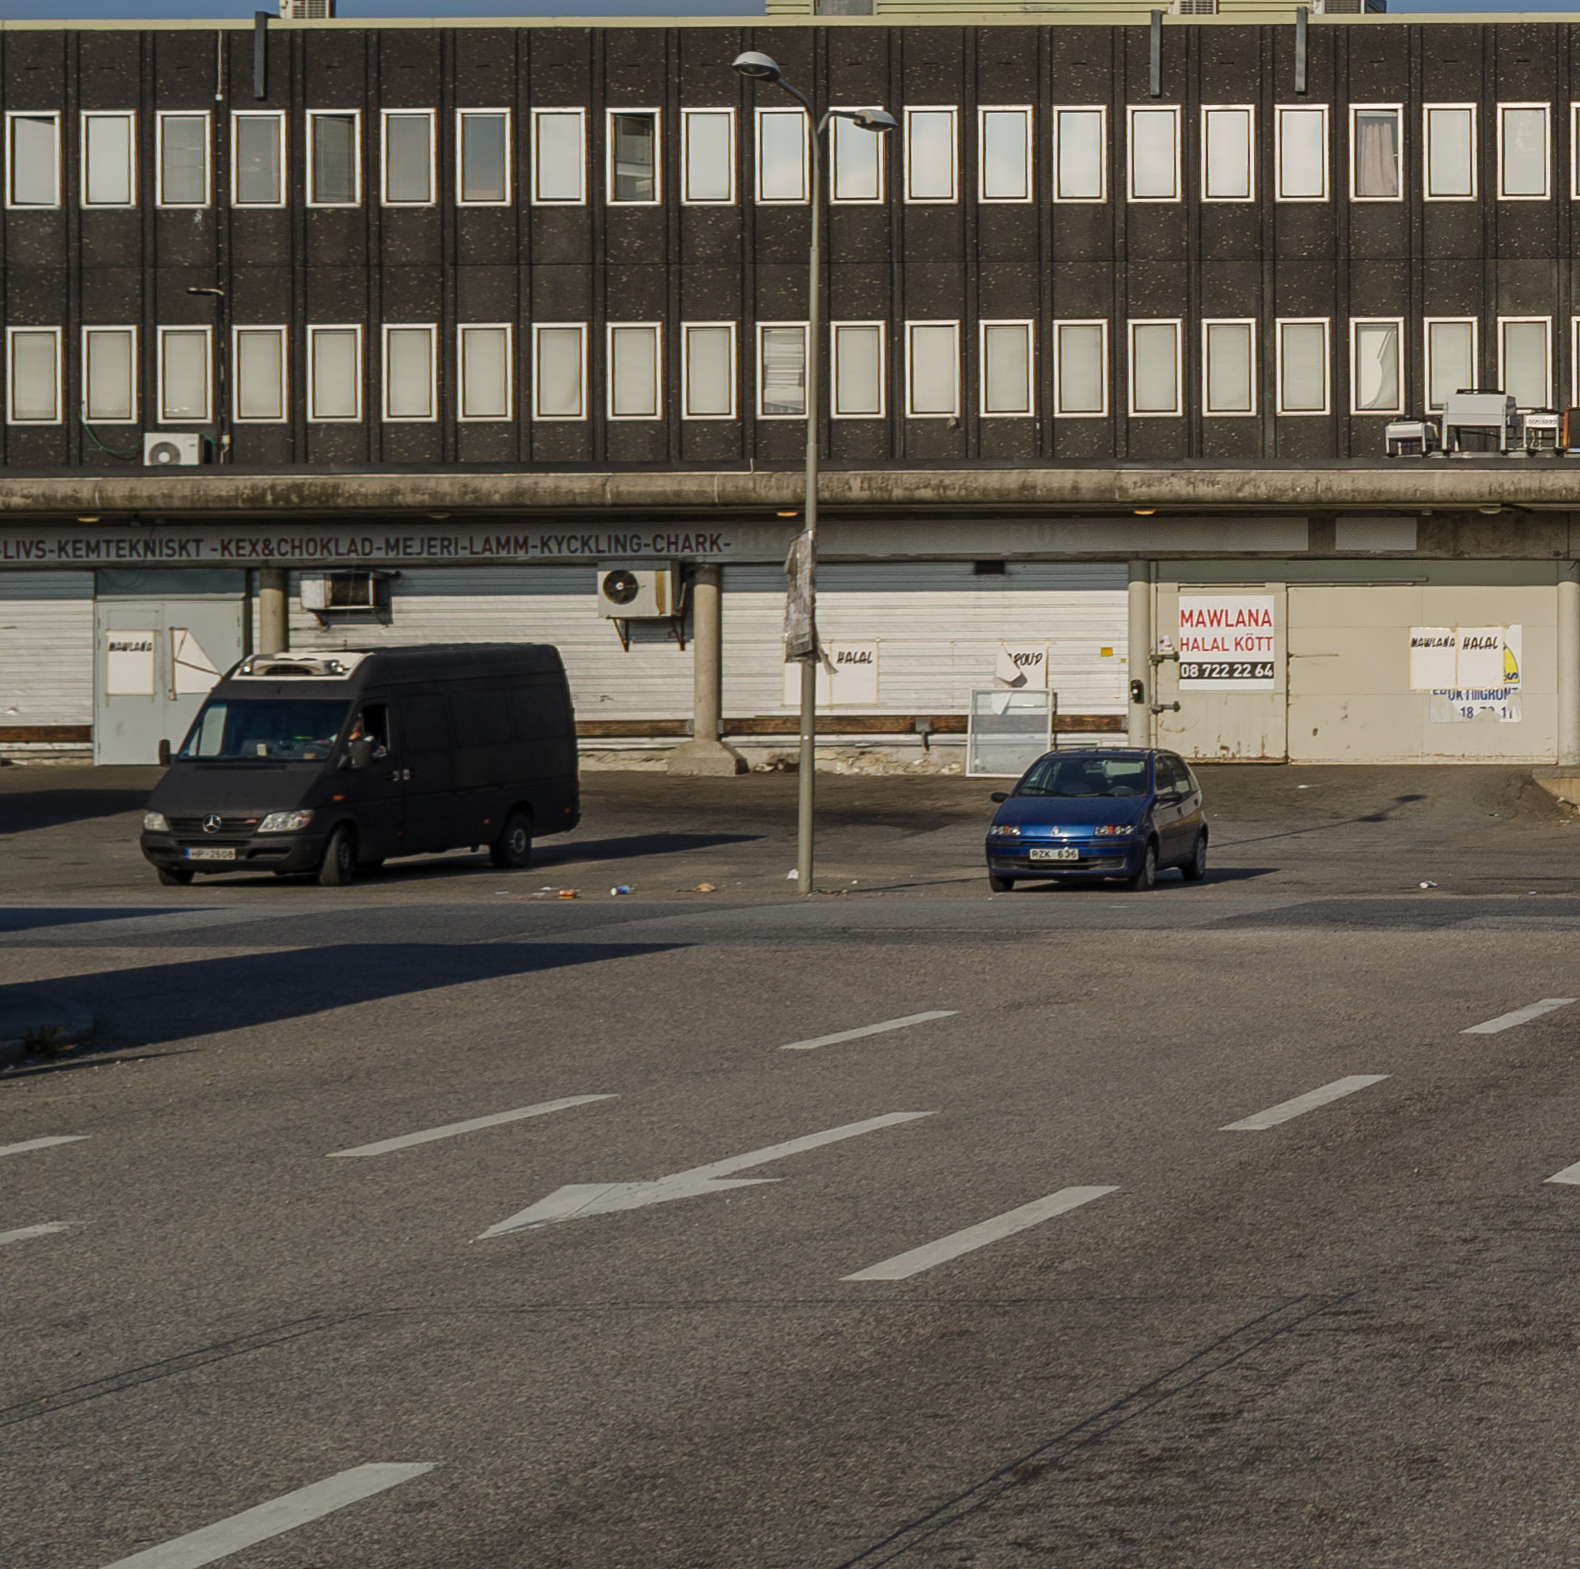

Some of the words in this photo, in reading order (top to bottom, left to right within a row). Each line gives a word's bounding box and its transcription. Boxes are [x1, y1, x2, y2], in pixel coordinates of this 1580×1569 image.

[1180, 608, 1273, 628] MAWLANA
[1180, 637, 1230, 652] HALAL
[1234, 632, 1274, 652] KÖTT
[1462, 636, 1499, 649] HALAL
[836, 650, 873, 665] HALAL
[1181, 663, 1199, 678] 08
[1202, 663, 1230, 678] 722
[1232, 663, 1252, 678] 22
[1255, 663, 1273, 677] 64
